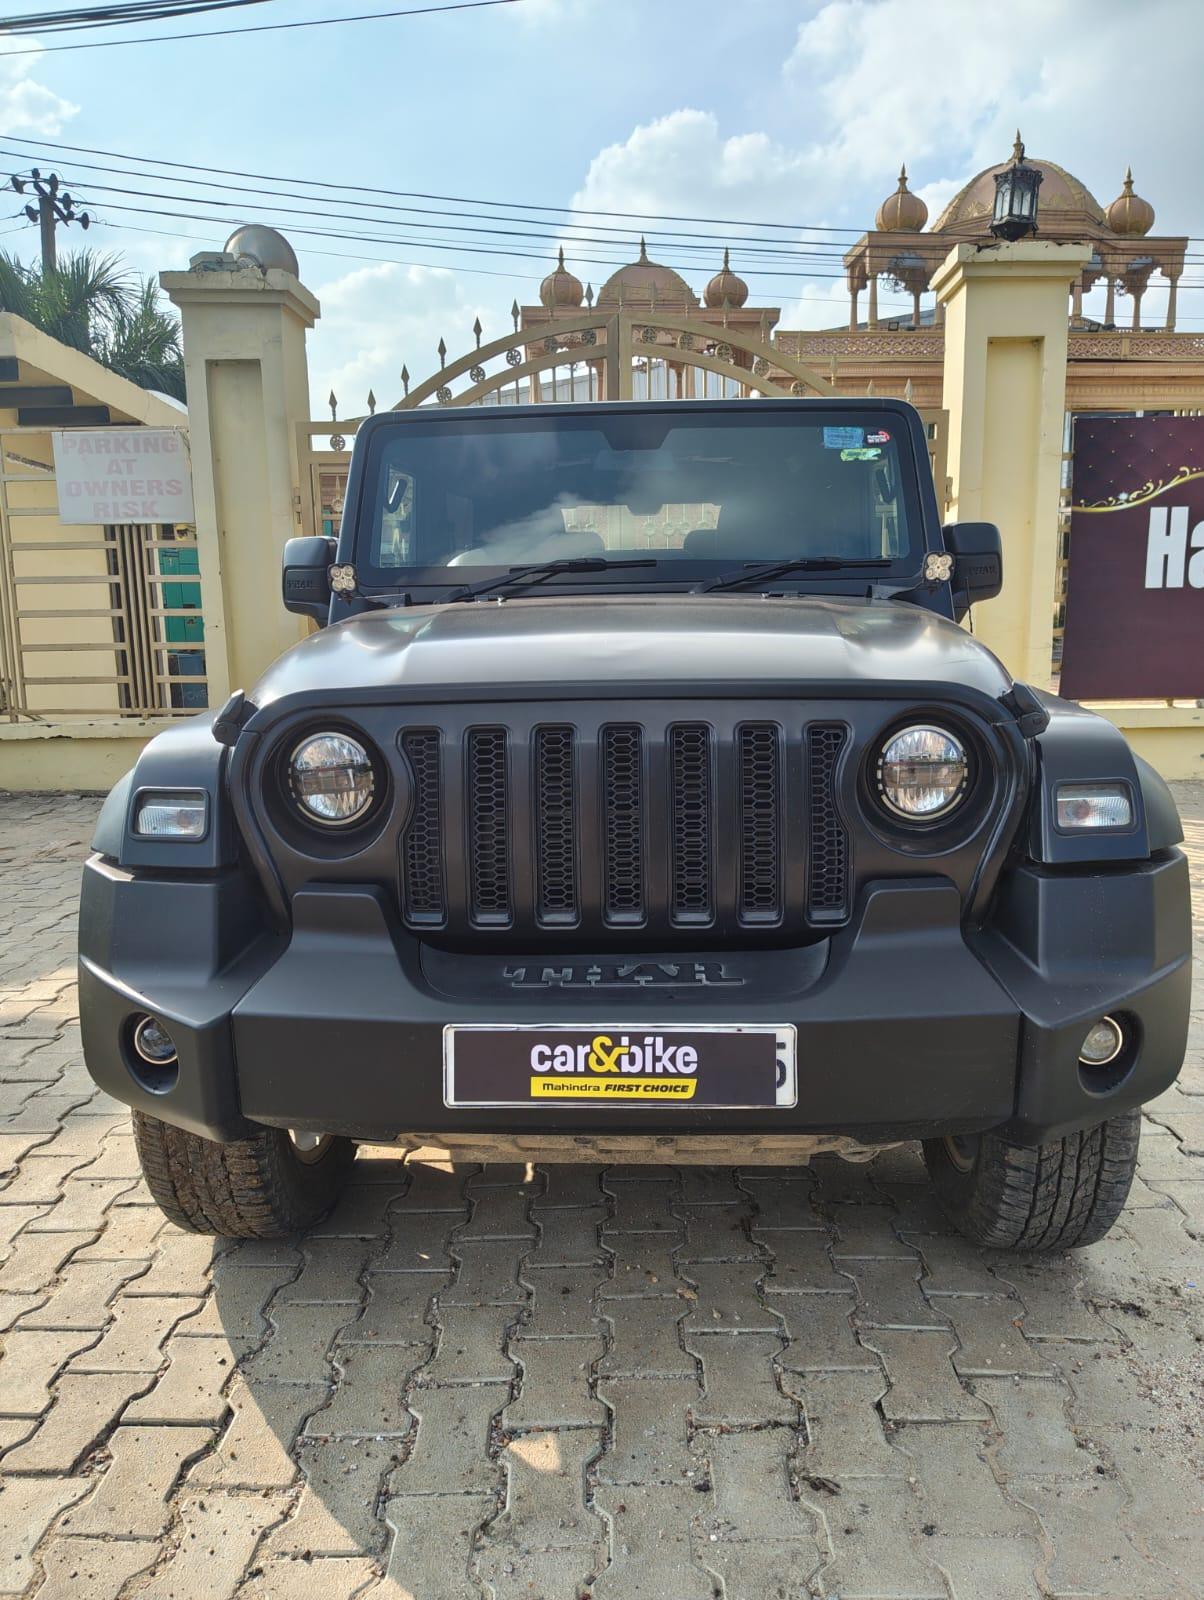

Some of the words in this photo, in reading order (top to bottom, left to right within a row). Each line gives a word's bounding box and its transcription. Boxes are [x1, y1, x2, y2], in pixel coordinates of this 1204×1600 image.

[62, 436, 180, 455] PARKING
[106, 458, 138, 476] AT
[64, 479, 184, 498] OWNERS
[92, 501, 161, 519] RISK
[530, 1035, 698, 1074] car&bike
[542, 1083, 601, 1092] Mahindra
[604, 1083, 642, 1093] FIRST
[643, 1084, 690, 1093] CHOICE
